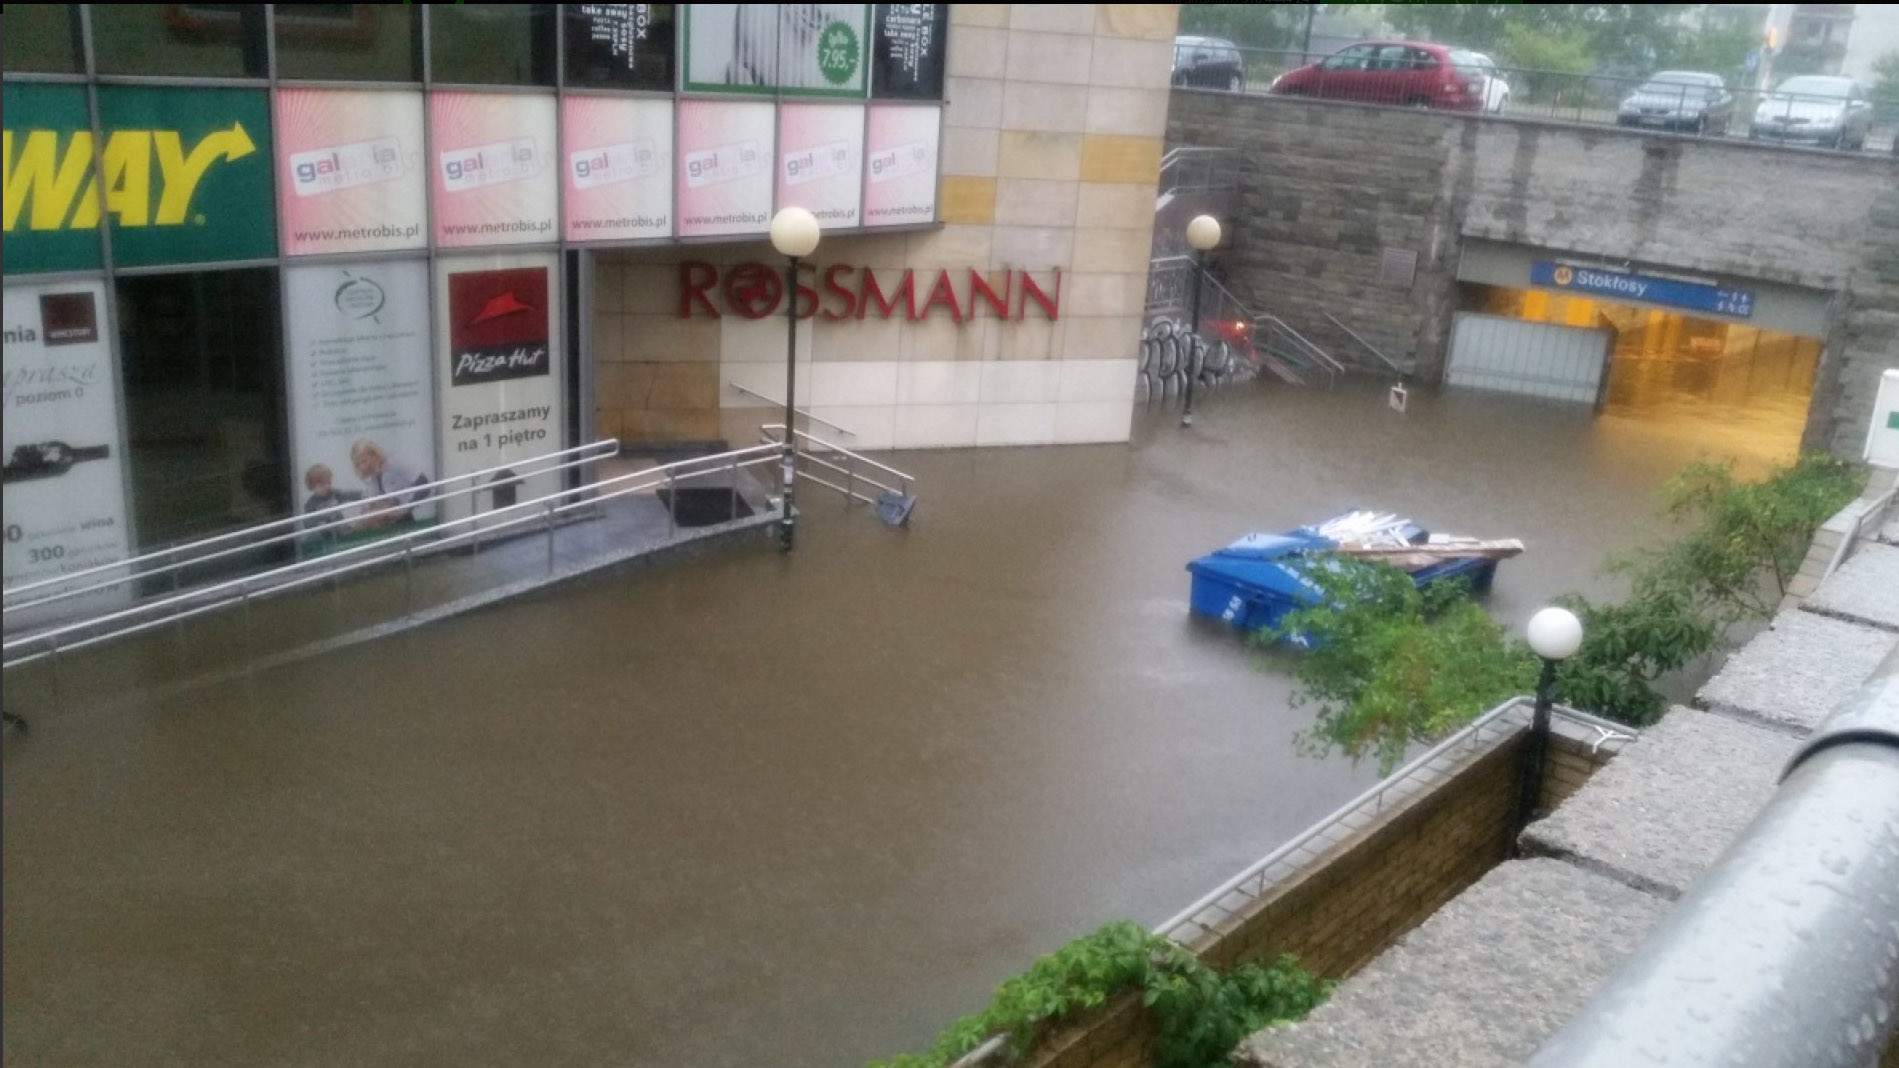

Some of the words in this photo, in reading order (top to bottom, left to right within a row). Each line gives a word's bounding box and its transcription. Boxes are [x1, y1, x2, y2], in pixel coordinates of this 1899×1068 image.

[685, 211, 768, 225] www.metrobis.pl
[867, 204, 933, 217] www.metrobis.pl
[443, 218, 551, 235] www.metrobis.pl
[572, 214, 667, 230] www.metrobis.pl
[295, 223, 419, 241] www.metrobis.pl
[679, 260, 1061, 322] ROSSMANN
[1576, 269, 1648, 297] Stokłosy
[456, 352, 507, 377] Pizza
[508, 347, 544, 369] Hut
[16, 388, 71, 406] poziom
[452, 404, 551, 430] Zapraszamy
[458, 438, 478, 452] na
[484, 432, 492, 447] 1
[498, 427, 547, 449] piętro
[80, 517, 115, 530] wina
[29, 545, 65, 565] 300
